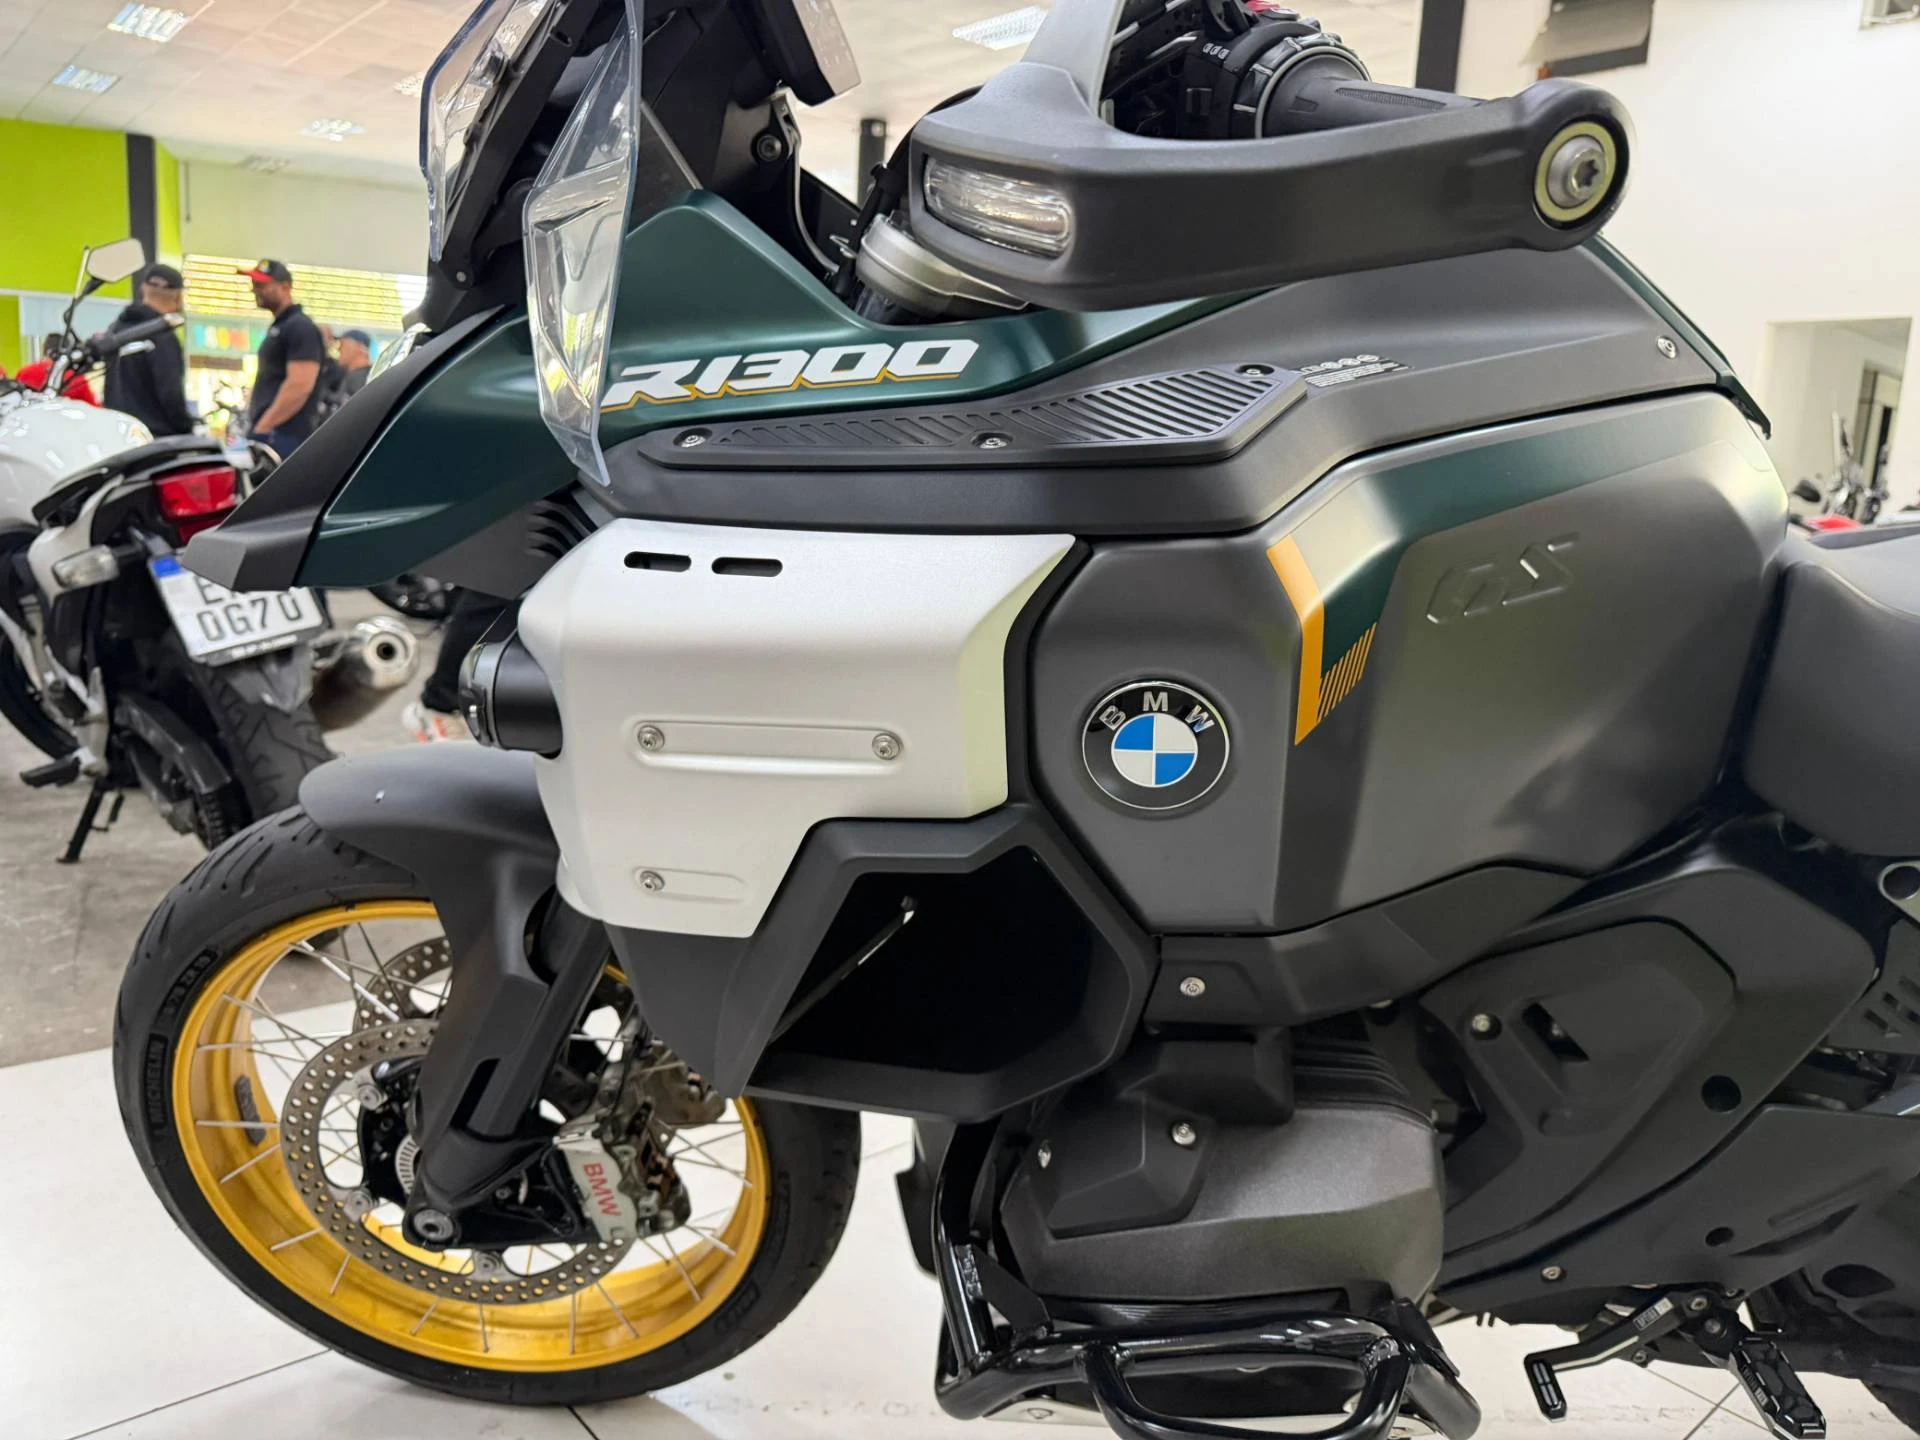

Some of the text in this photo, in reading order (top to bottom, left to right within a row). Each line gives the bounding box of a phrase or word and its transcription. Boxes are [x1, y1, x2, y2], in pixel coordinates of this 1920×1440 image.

[599, 338, 980, 410] R1300
[1426, 531, 1580, 624] GS
[1098, 690, 1216, 733] BMW
[147, 1041, 166, 1123] MICHELIN
[583, 1162, 622, 1217] BMW
